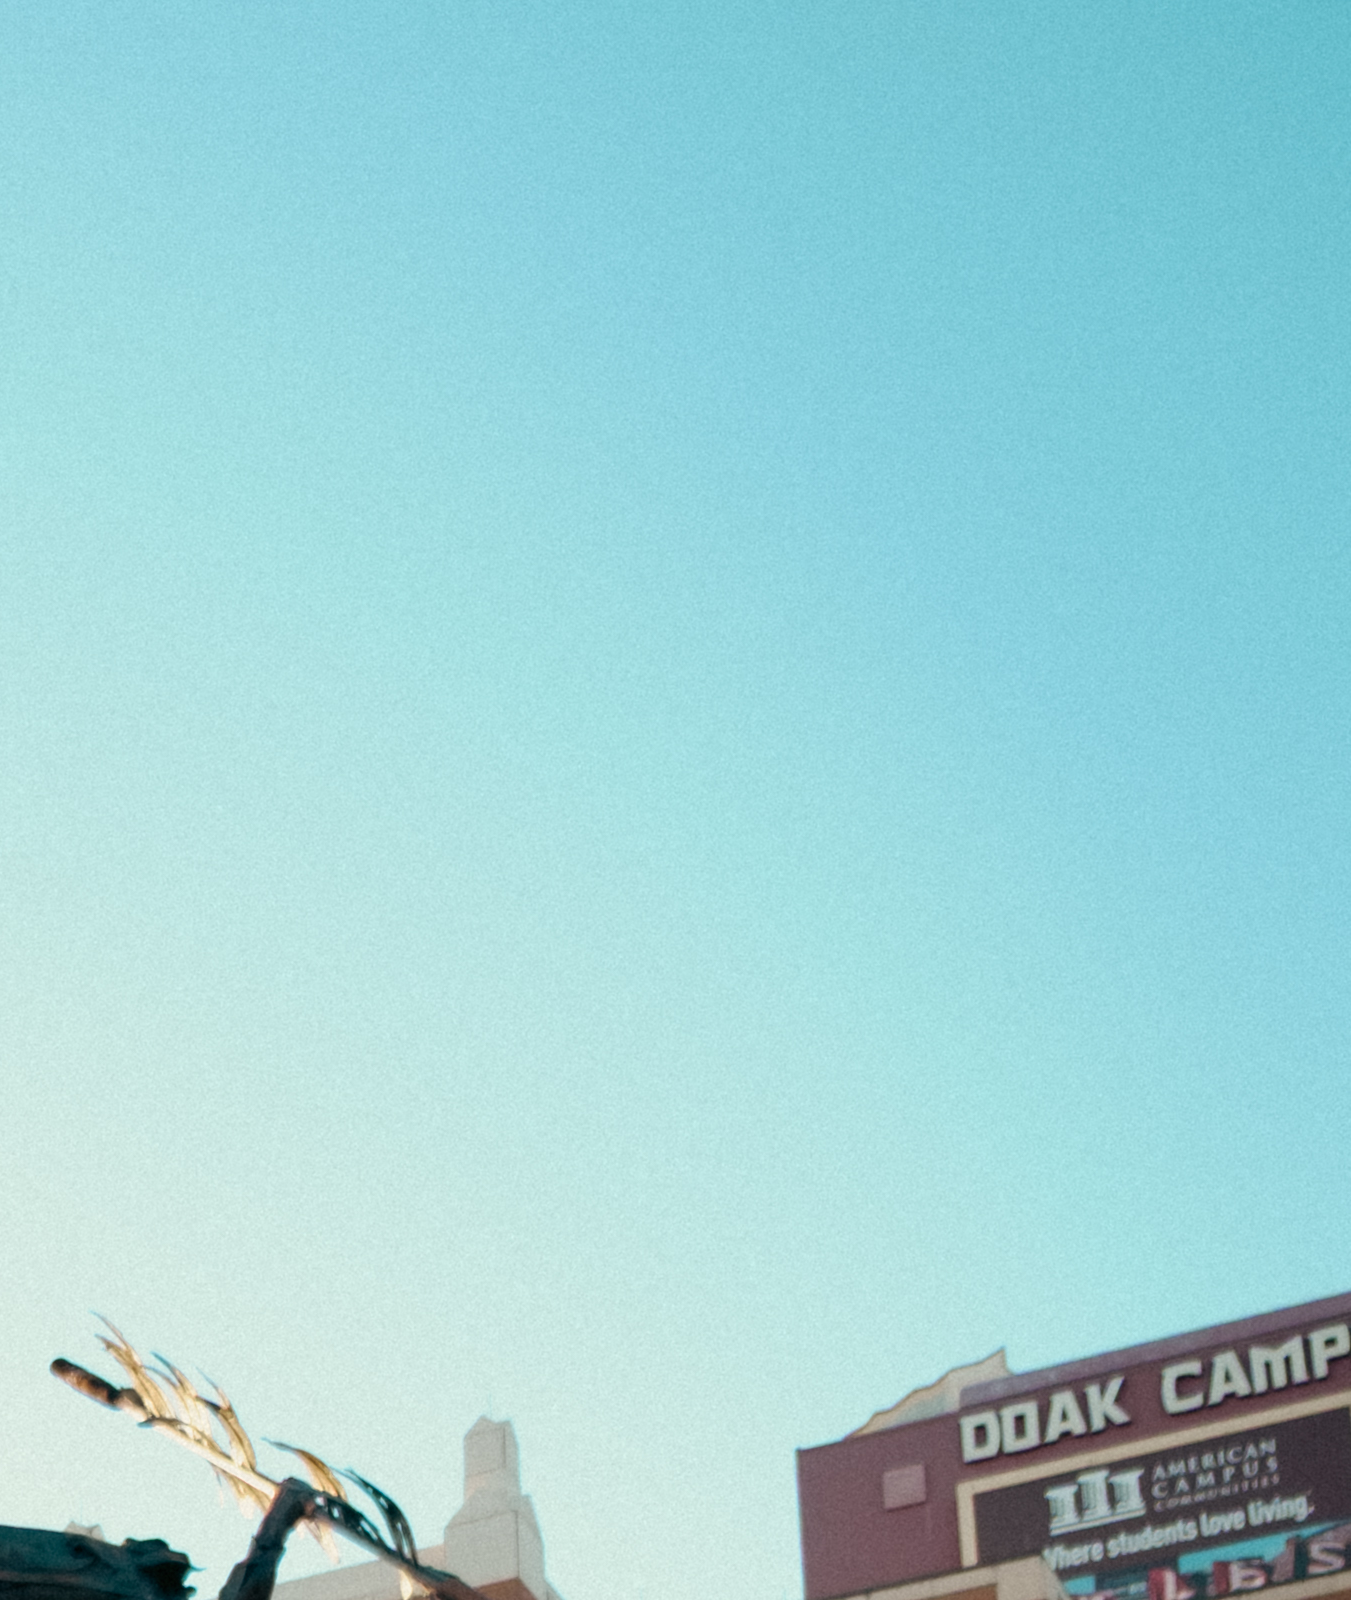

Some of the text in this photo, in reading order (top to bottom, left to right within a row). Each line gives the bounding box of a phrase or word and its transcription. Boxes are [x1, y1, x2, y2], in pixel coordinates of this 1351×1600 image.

[958, 1322, 1351, 1463] DOAK CAMP
[1150, 1456, 1278, 1500] CAMPUS
[1151, 1438, 1278, 1483] AMERICAN
[1106, 1518, 1198, 1559] students
[1199, 1508, 1247, 1538] love
